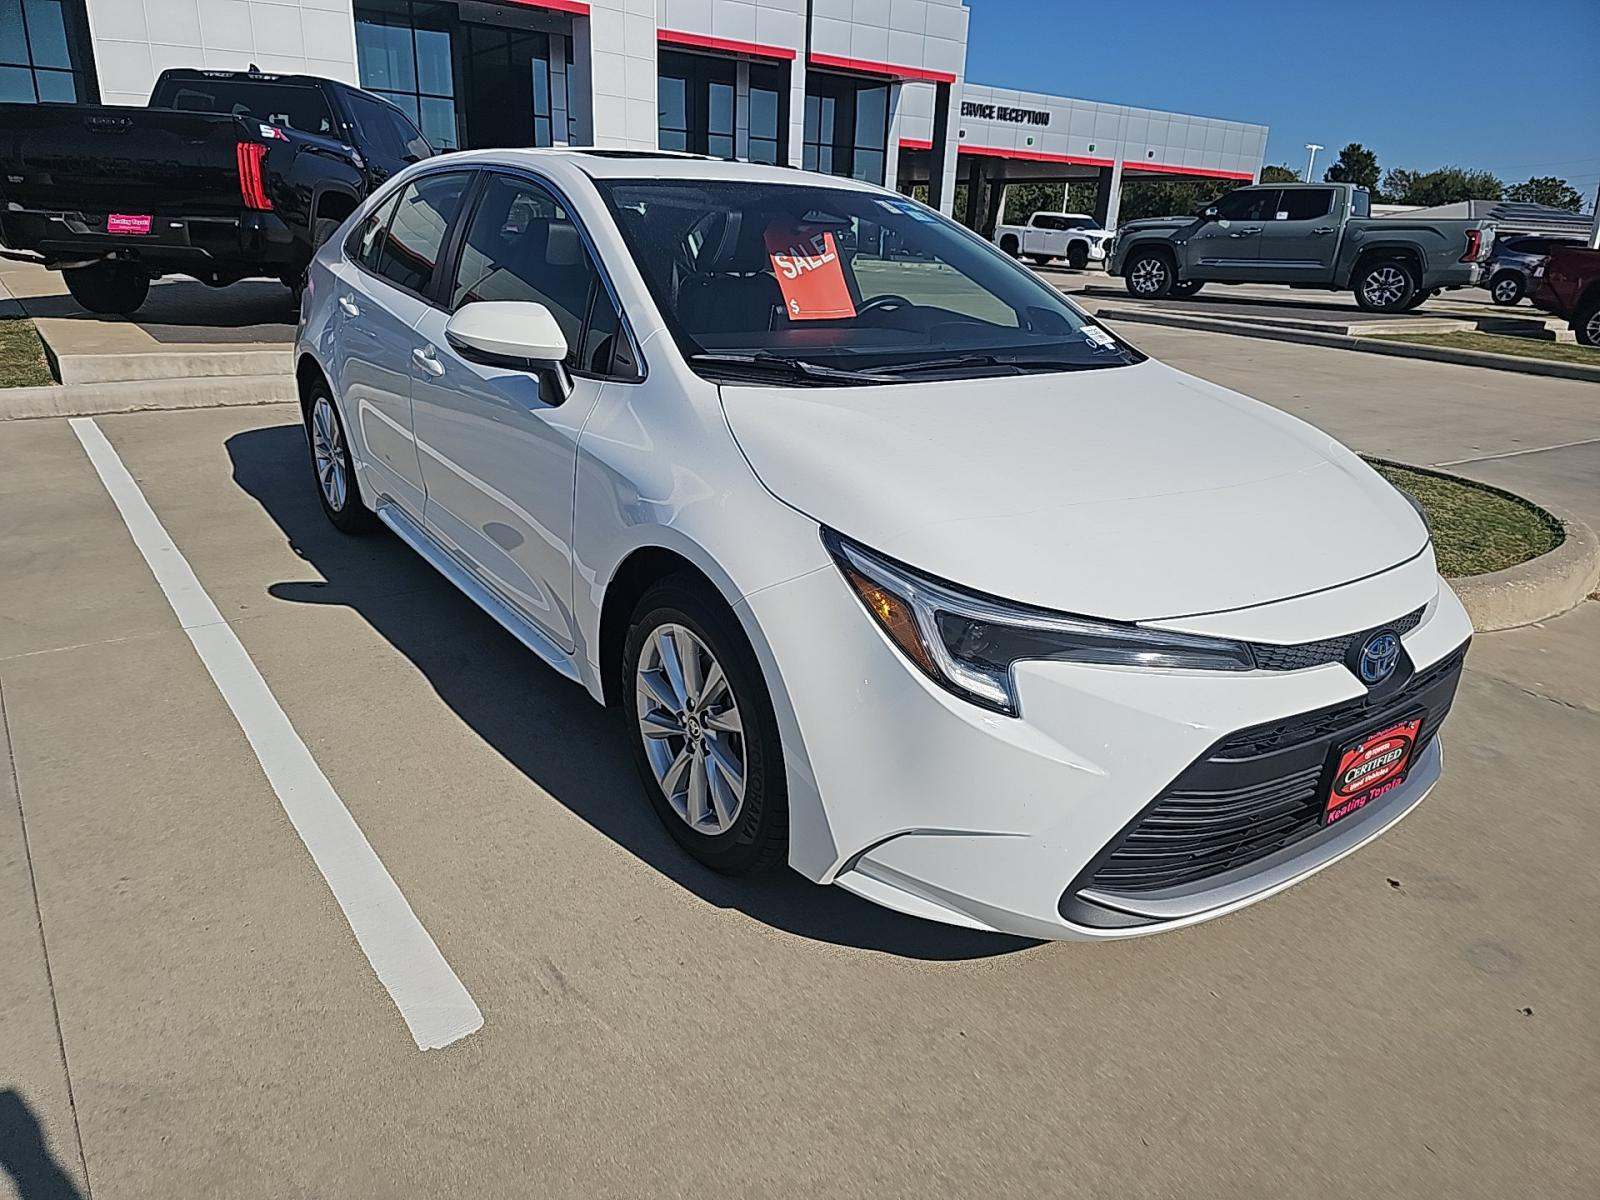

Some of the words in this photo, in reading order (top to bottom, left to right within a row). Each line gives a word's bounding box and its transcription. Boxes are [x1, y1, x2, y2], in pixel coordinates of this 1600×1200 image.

[960, 101, 996, 120] ERVICE
[996, 106, 1050, 127] RECEPTION
[774, 233, 836, 279] SALE
[1345, 749, 1402, 783] CERTIFIED
[1327, 796, 1367, 824] Keating
[1369, 778, 1403, 799] Toyota
